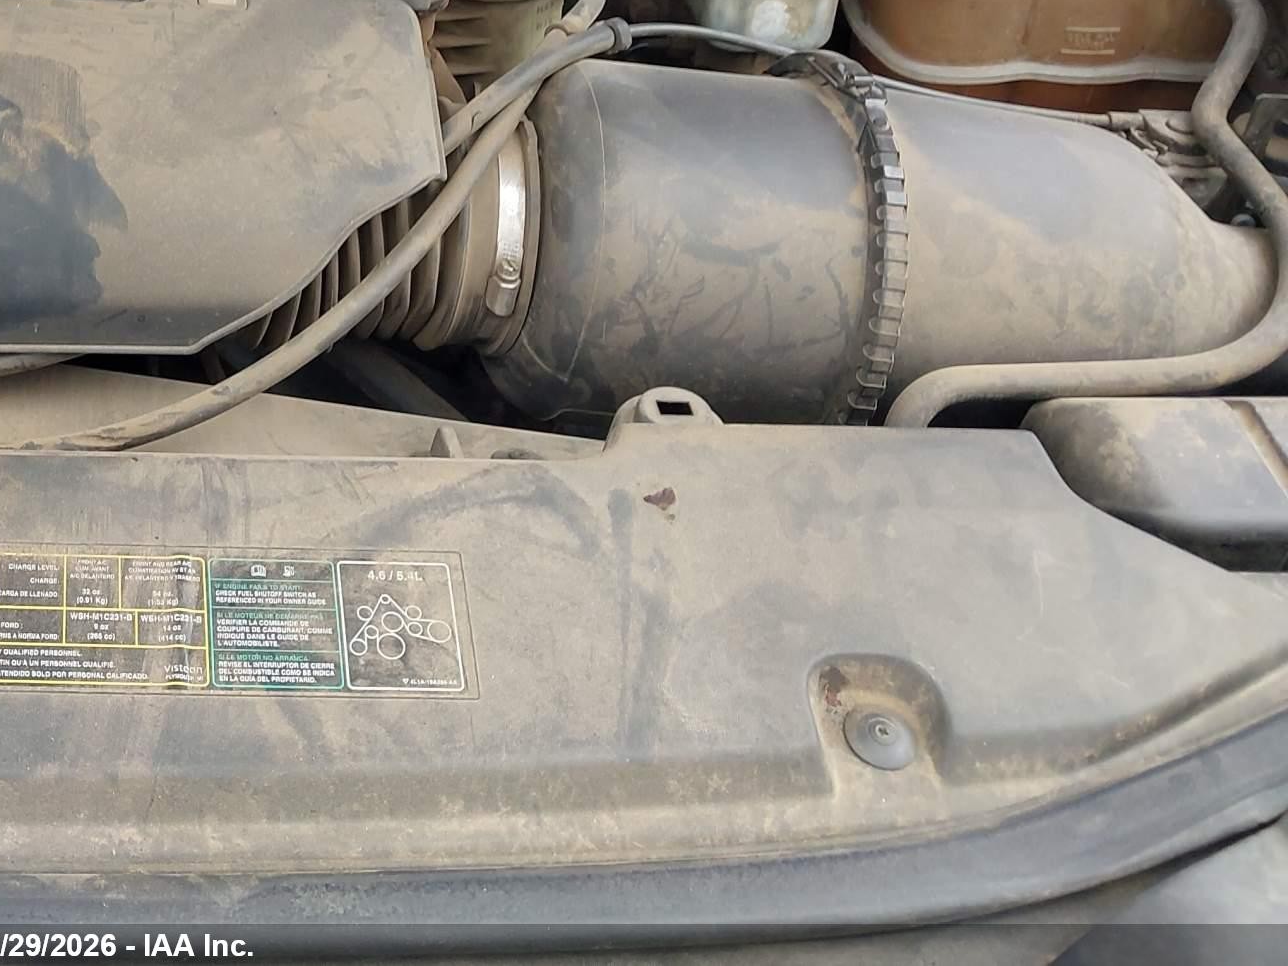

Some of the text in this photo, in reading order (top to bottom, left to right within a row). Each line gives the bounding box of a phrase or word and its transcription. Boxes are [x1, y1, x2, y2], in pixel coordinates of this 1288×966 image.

[367, 570, 386, 580] 4.6
[95, 597, 108, 605] Kg)
[164, 664, 203, 674] Visteon
